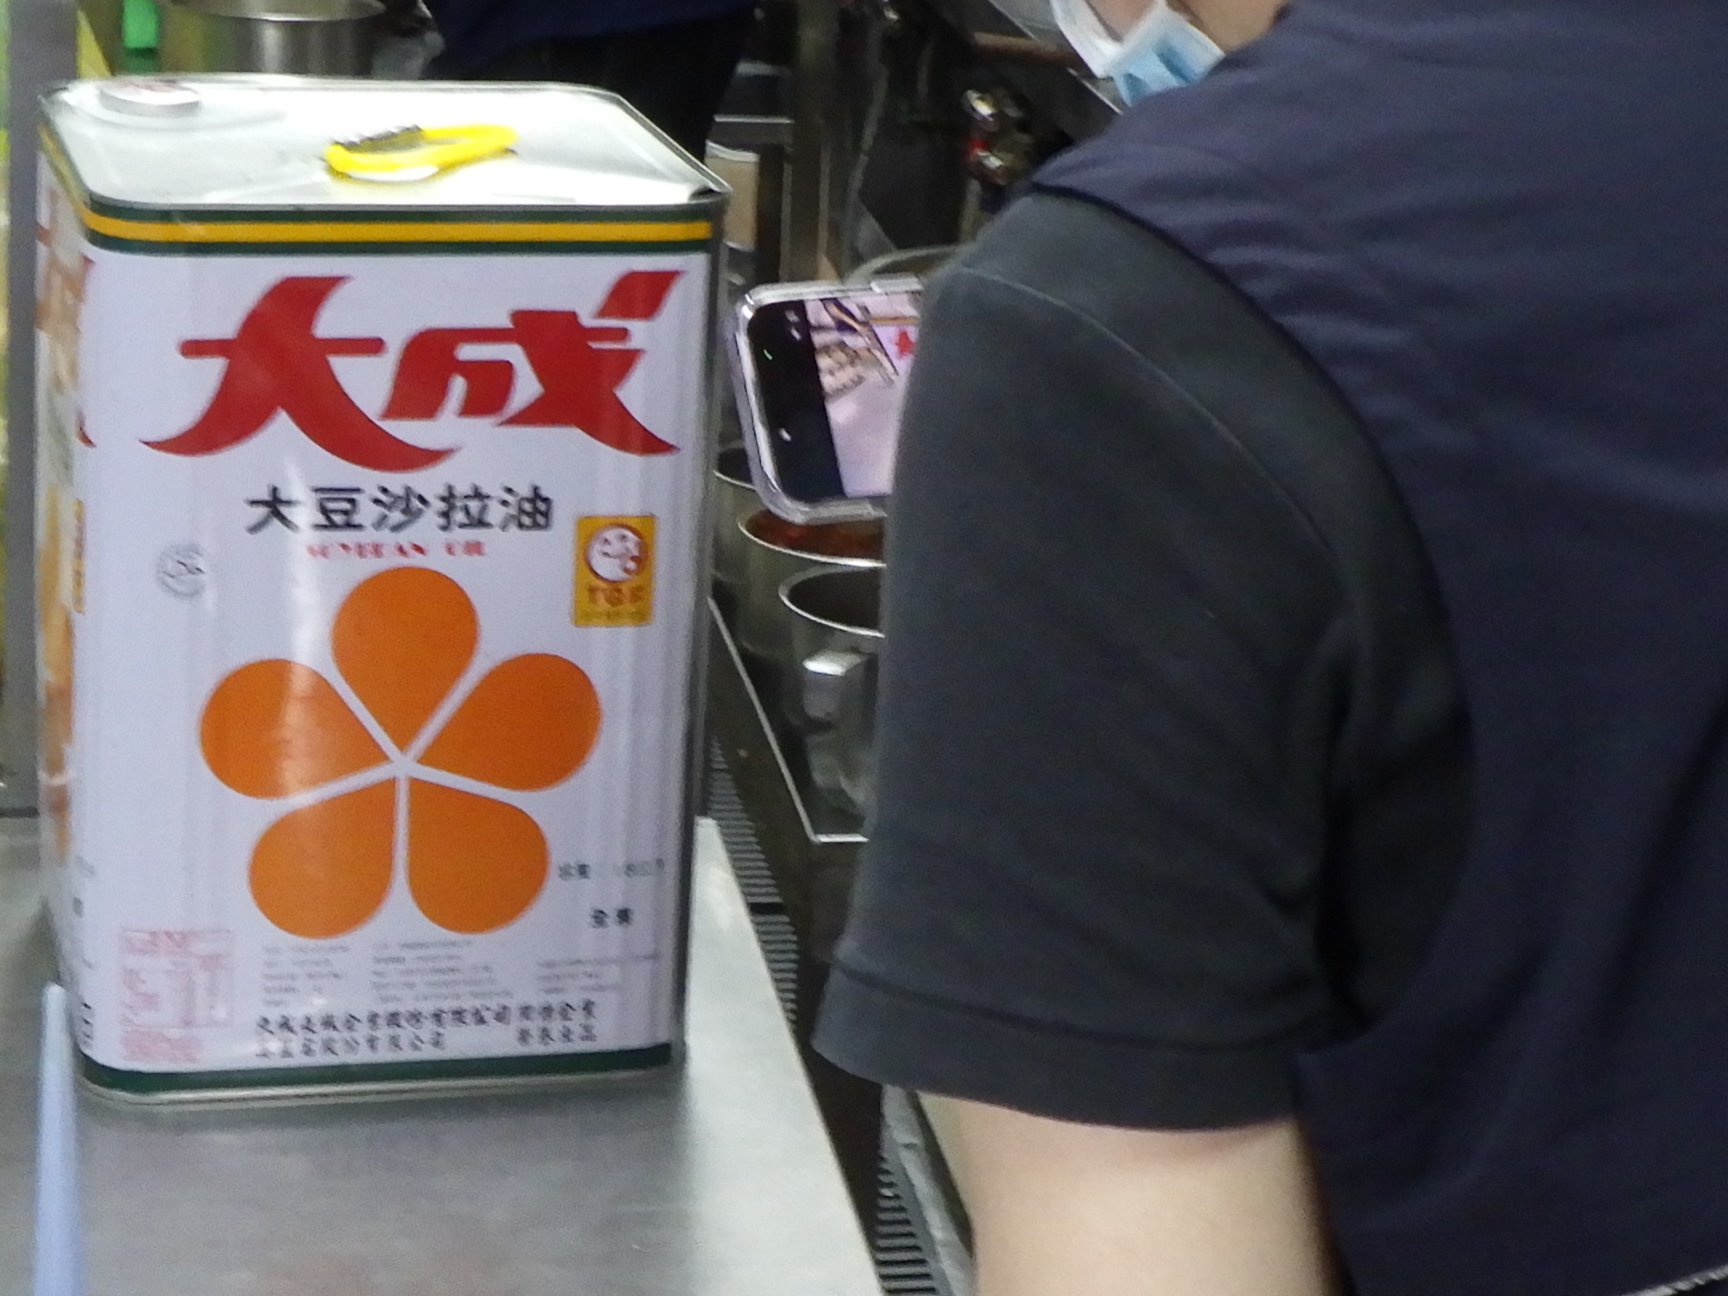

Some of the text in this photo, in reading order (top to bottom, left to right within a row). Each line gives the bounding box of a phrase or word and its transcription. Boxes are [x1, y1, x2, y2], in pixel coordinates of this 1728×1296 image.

[139, 268, 687, 473] 大成
[244, 483, 554, 535] 大豆沙拉油
